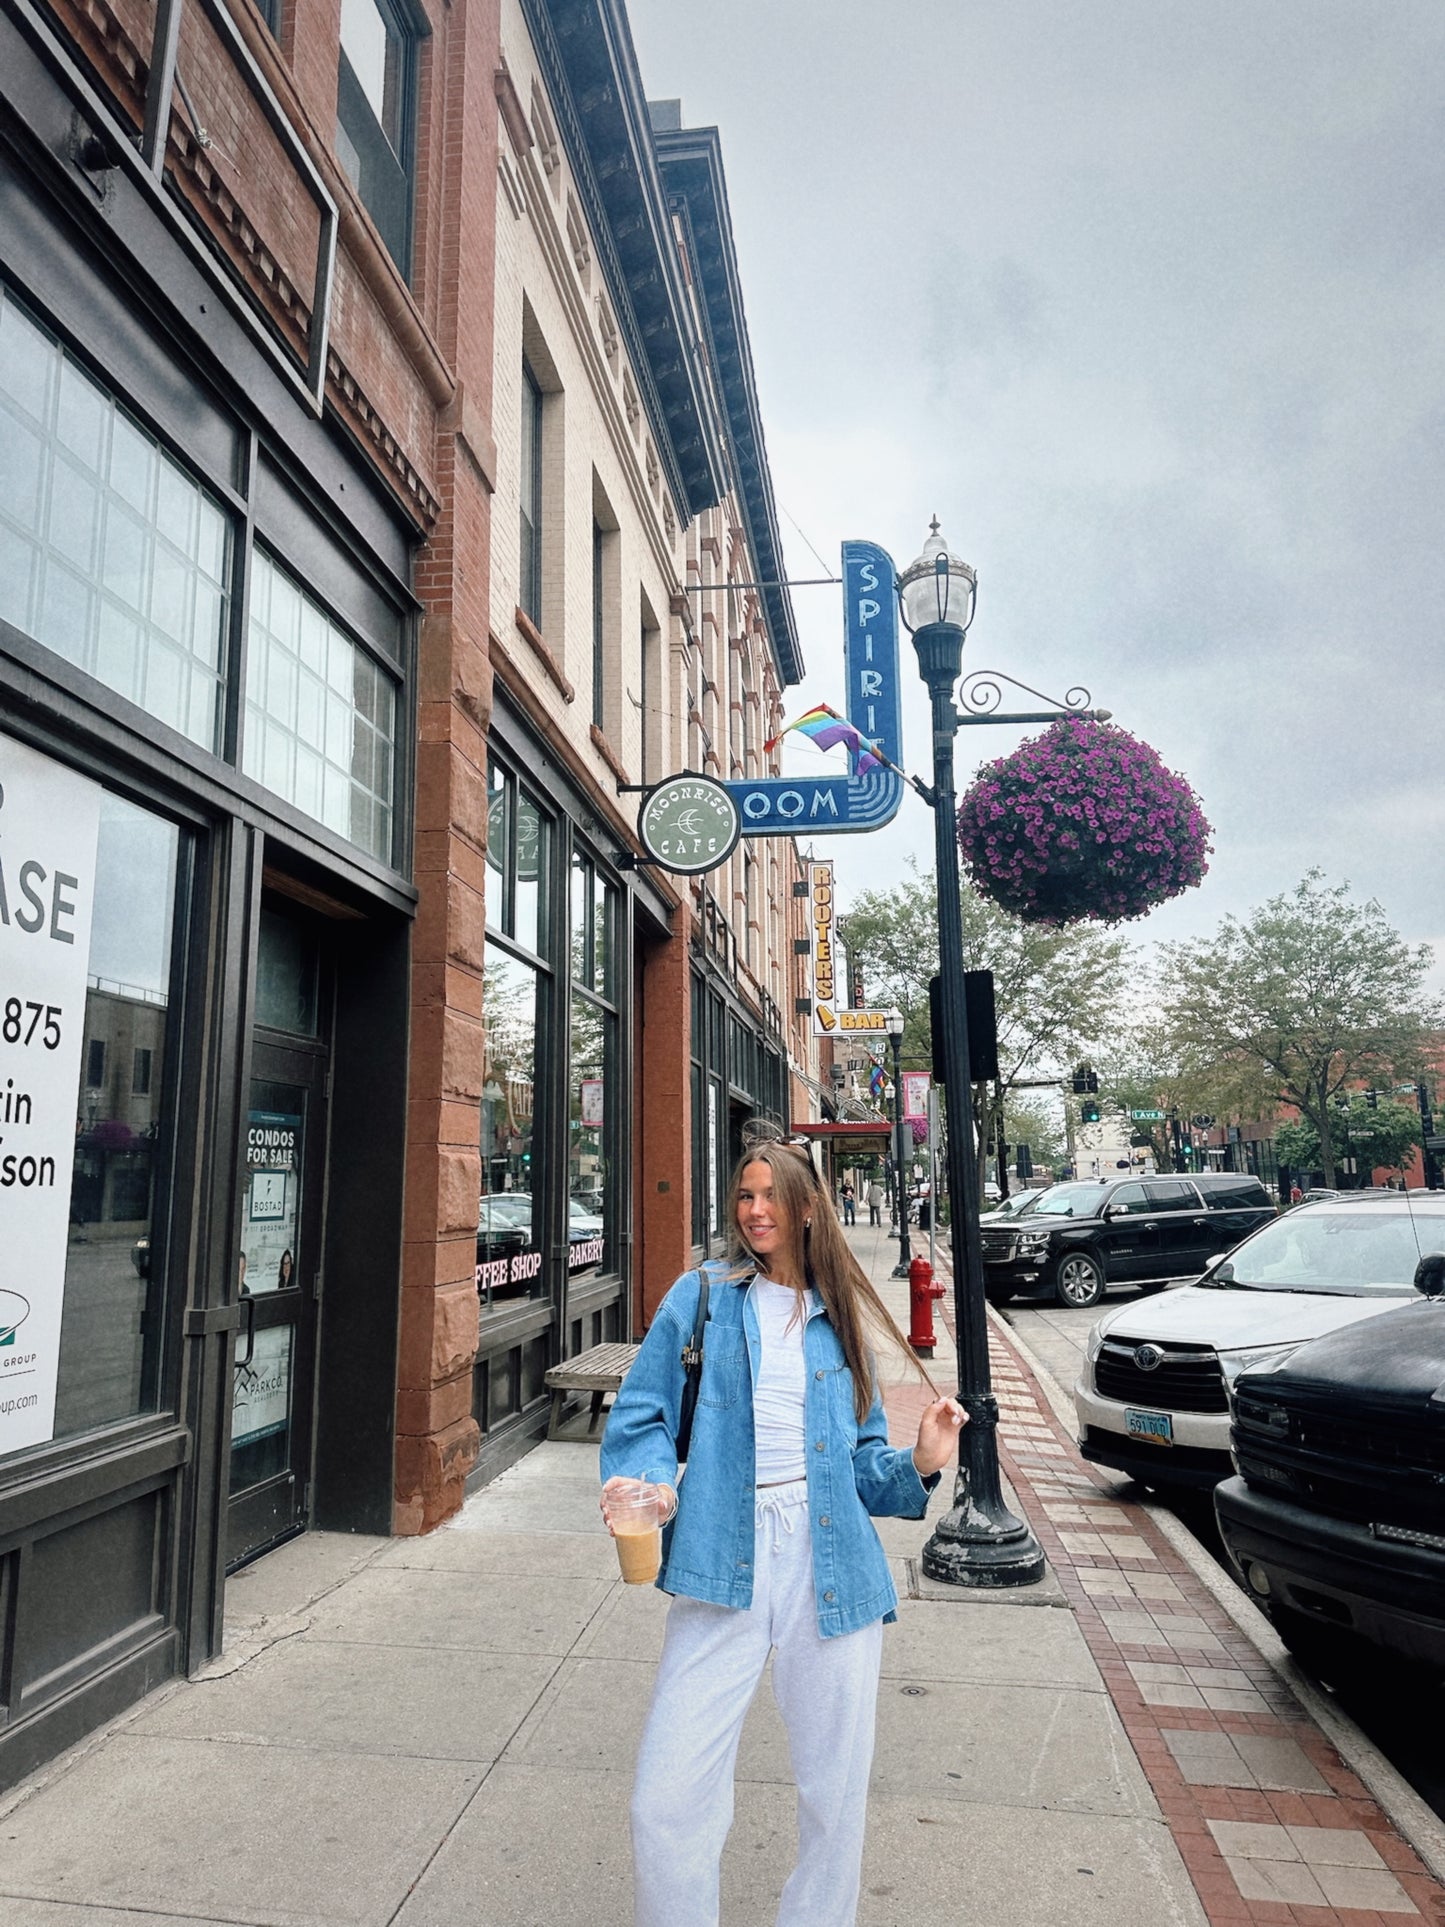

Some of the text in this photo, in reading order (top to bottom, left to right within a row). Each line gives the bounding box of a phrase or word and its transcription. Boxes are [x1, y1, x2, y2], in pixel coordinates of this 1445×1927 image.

[649, 786, 729, 822] MOONRISE
[661, 838, 717, 855] CAFE
[813, 866, 833, 1001] ROOTERS
[2, 997, 63, 1051] 875
[840, 1013, 887, 1031] BAR
[1140, 1111, 1156, 1119] Ave
[248, 1128, 294, 1148] CONDOS
[246, 1147, 293, 1164] FOR SALE
[254, 1201, 282, 1212] BOSTAD
[567, 1238, 605, 1269] BAKERY
[510, 1252, 542, 1283] SHOP
[3, 1353, 37, 1367] GROUP
[250, 1376, 283, 1396] PARKCO
[0, 1393, 38, 1415] up.com
[1130, 1418, 1147, 1434] 591
